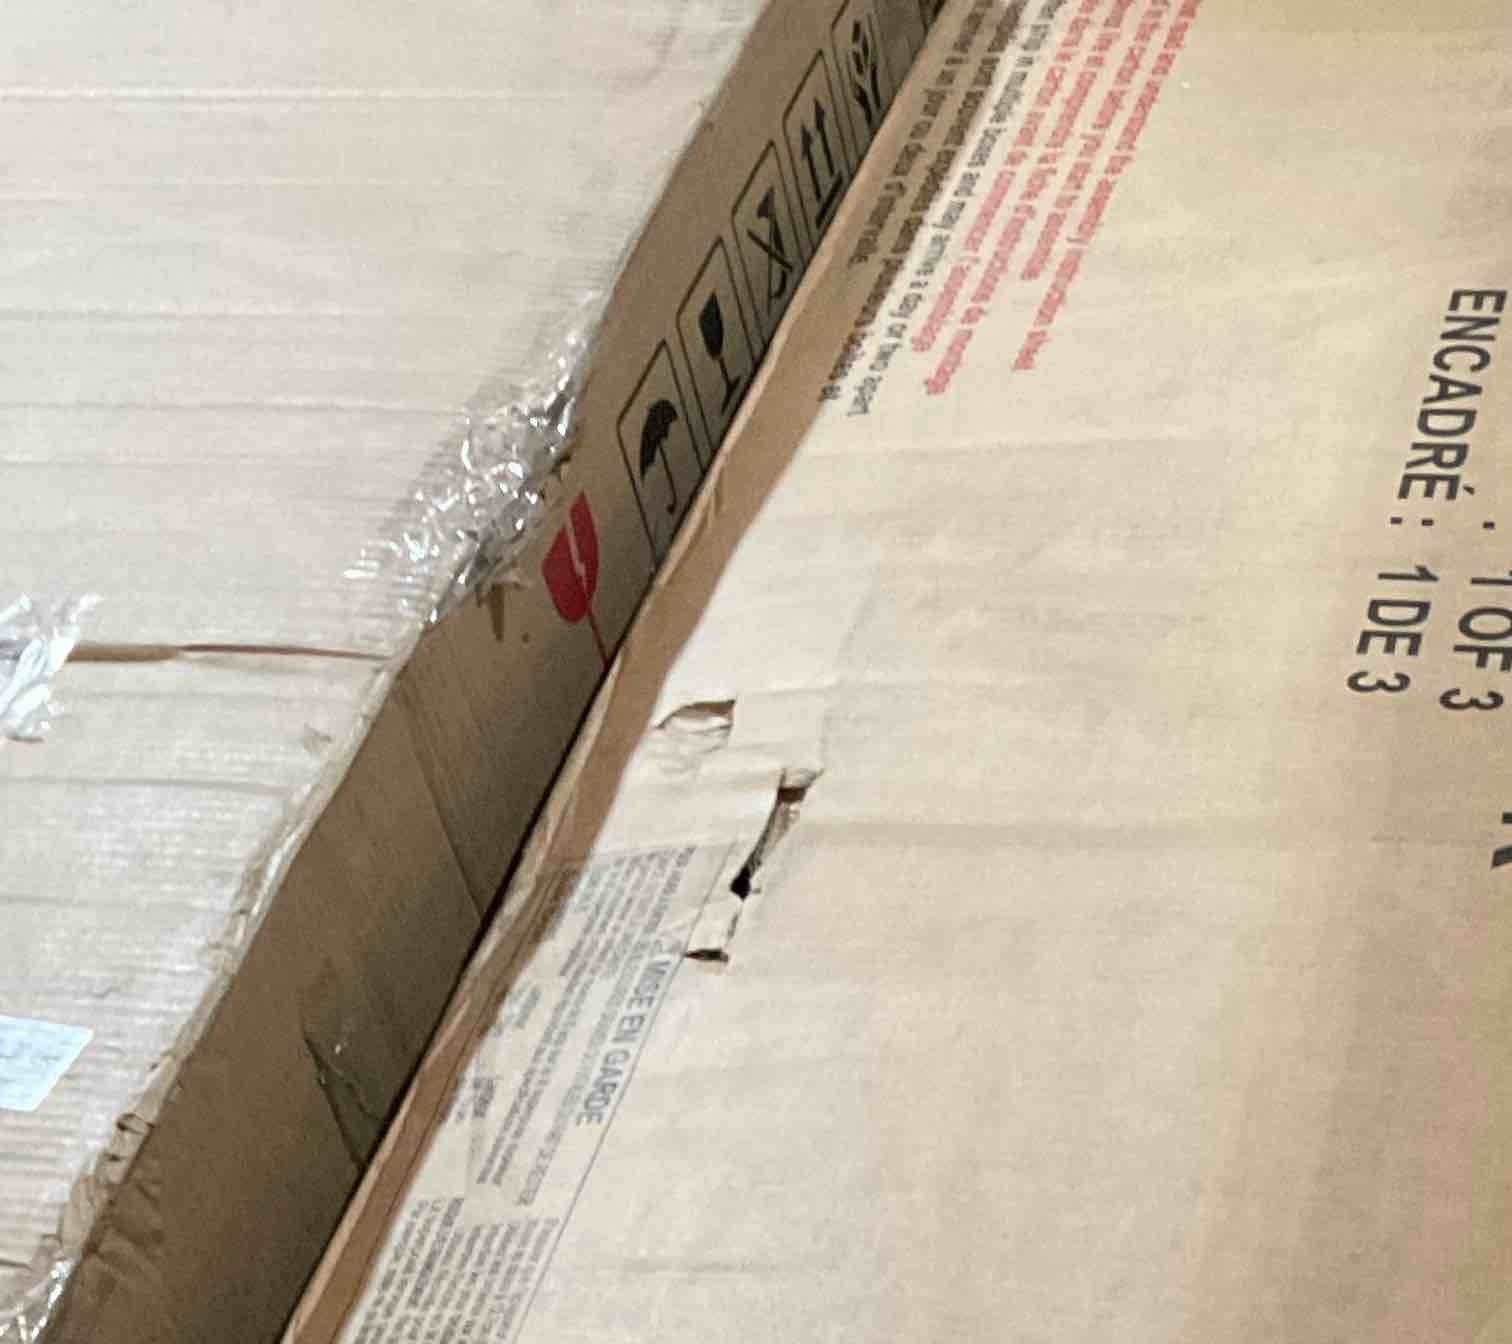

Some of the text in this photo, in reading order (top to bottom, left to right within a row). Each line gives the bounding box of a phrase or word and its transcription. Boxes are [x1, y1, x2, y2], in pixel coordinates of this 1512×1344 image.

[1398, 290, 1506, 500] ENCADRÉ
[1378, 566, 1438, 581] 1
[1357, 600, 1430, 656] DE
[1348, 672, 1410, 692] 3
[1440, 689, 1503, 710] 3
